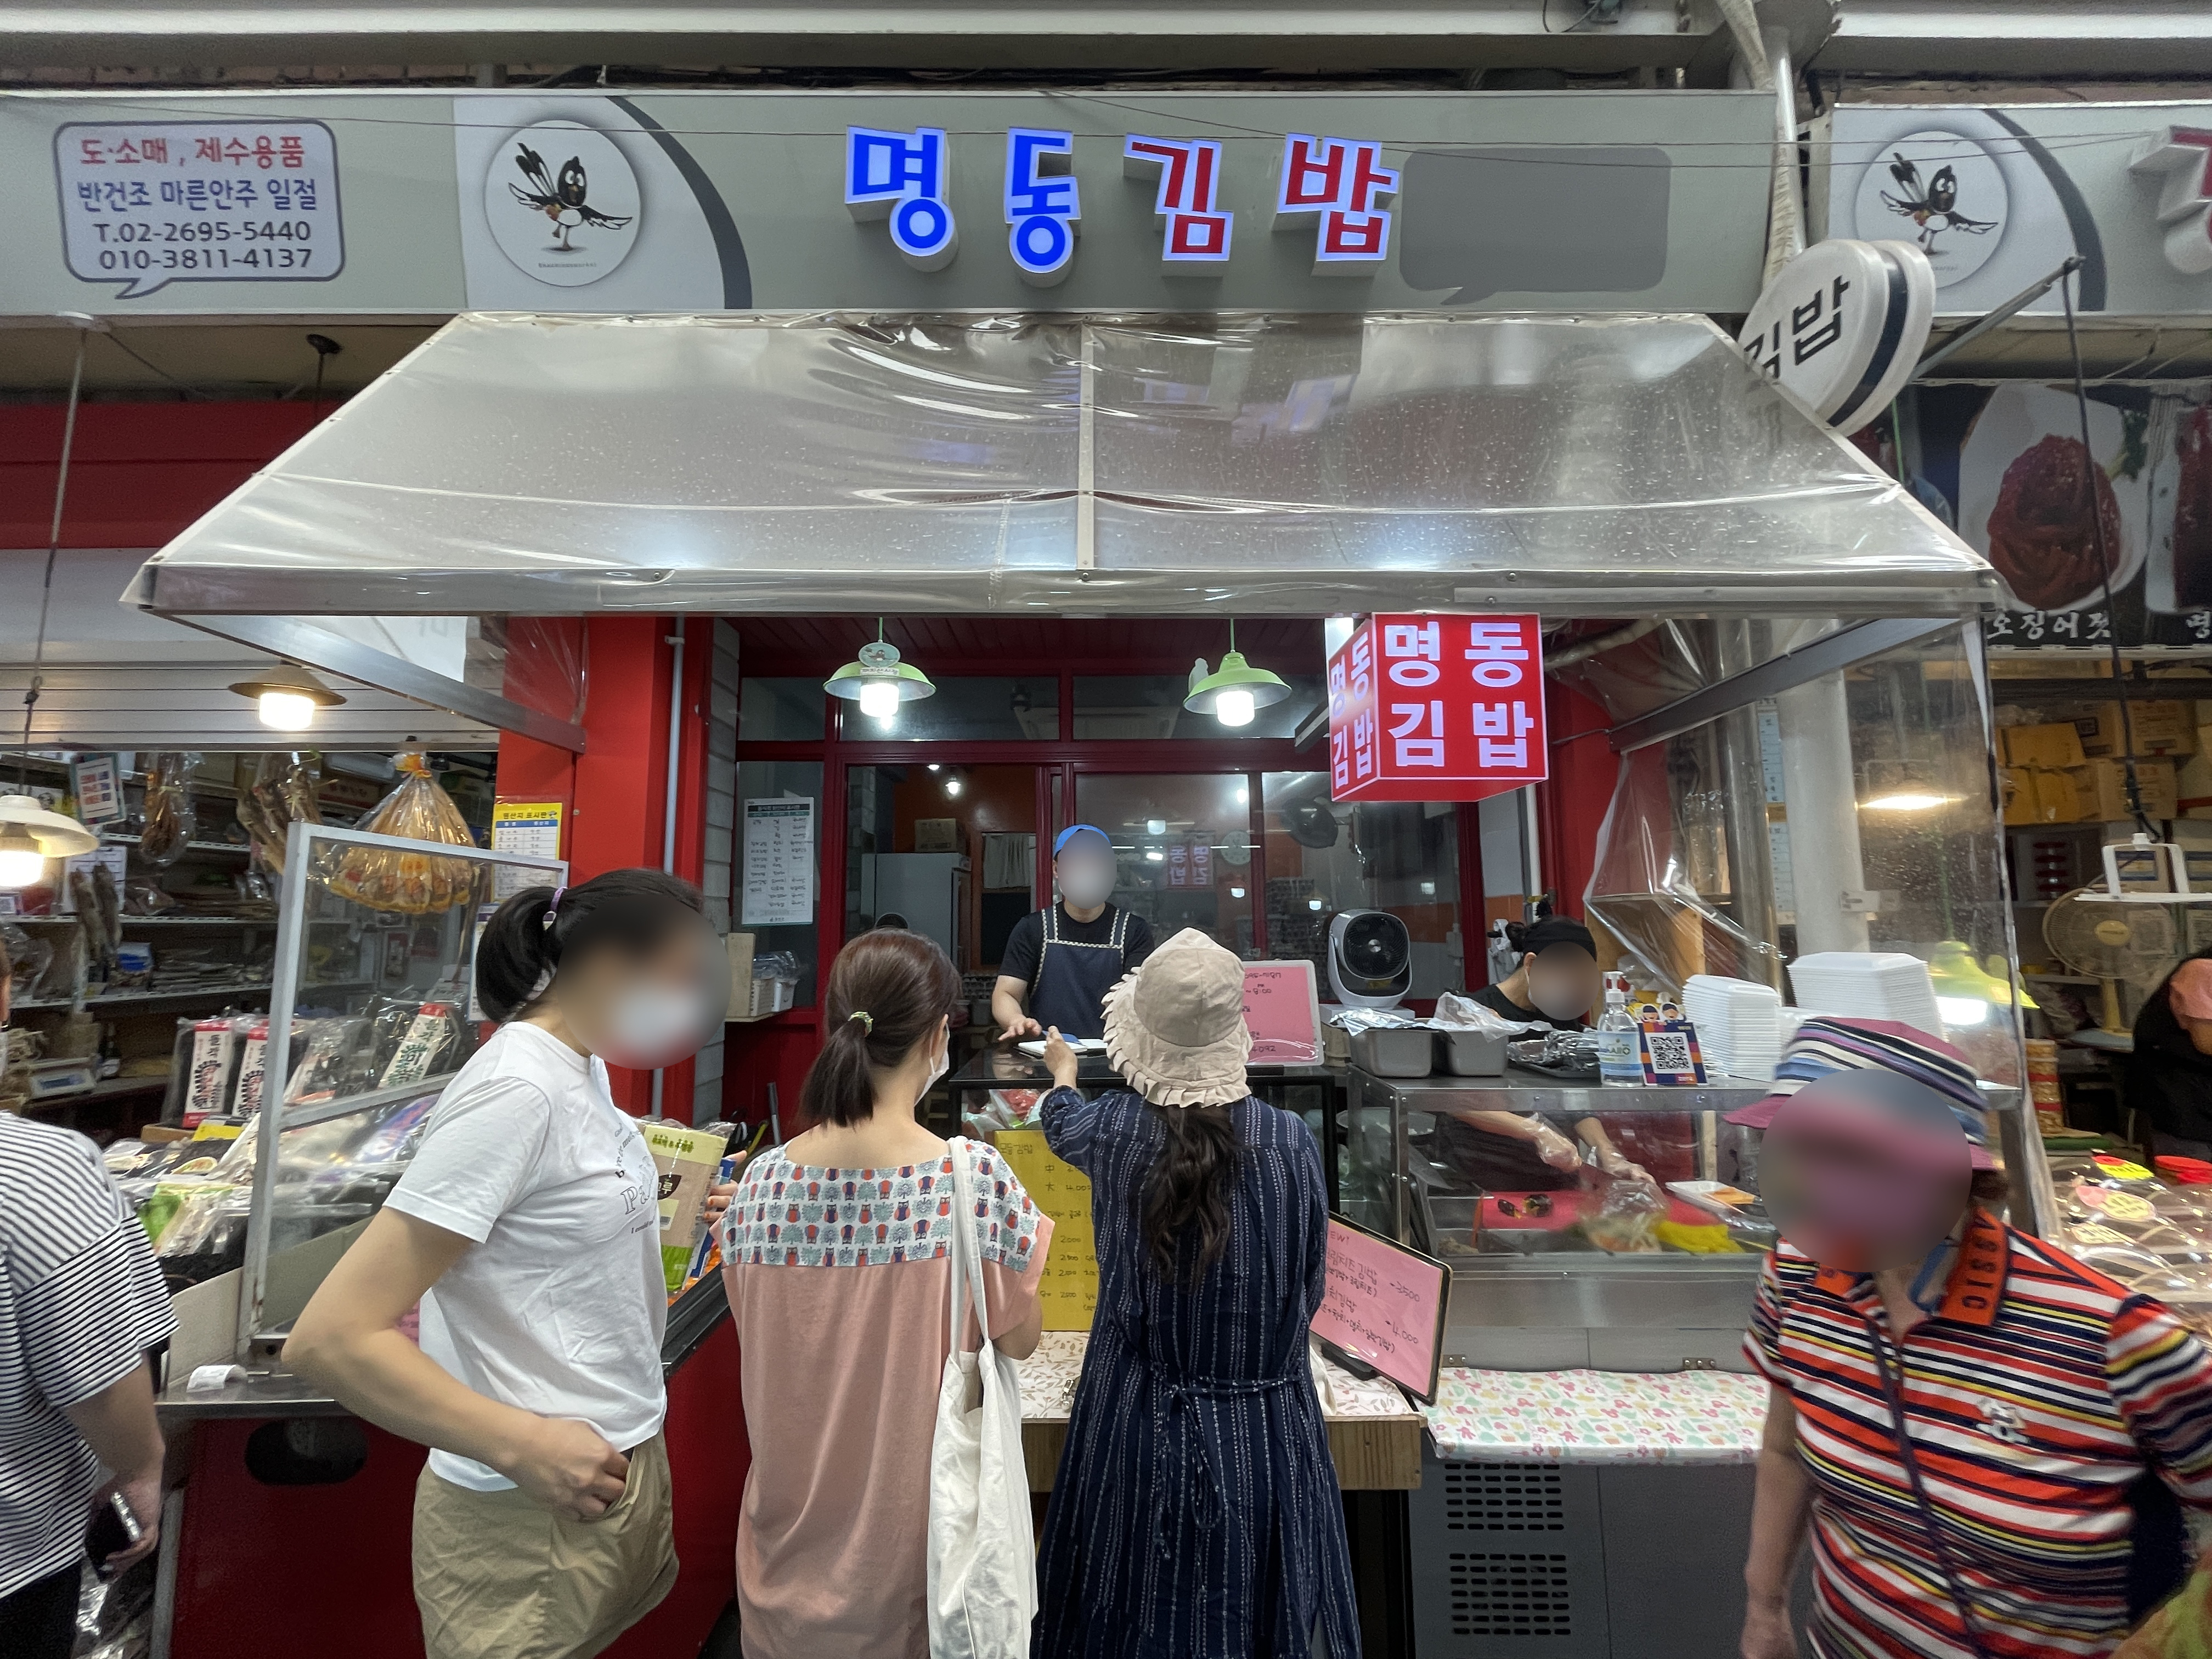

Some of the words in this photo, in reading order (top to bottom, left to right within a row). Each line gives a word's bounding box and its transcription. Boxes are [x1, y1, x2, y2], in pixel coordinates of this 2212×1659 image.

[195, 136, 304, 169] 제수용품
[77, 180, 152, 212] 반건조
[162, 179, 258, 211] 마른안주
[268, 178, 317, 211] 일절
[94, 221, 312, 242] T.02-2695-5440
[99, 249, 313, 269] 010-3811-4137
[1385, 621, 1529, 687] 명동
[1333, 709, 1373, 789] 김밥
[1387, 700, 1534, 768] 김밥
